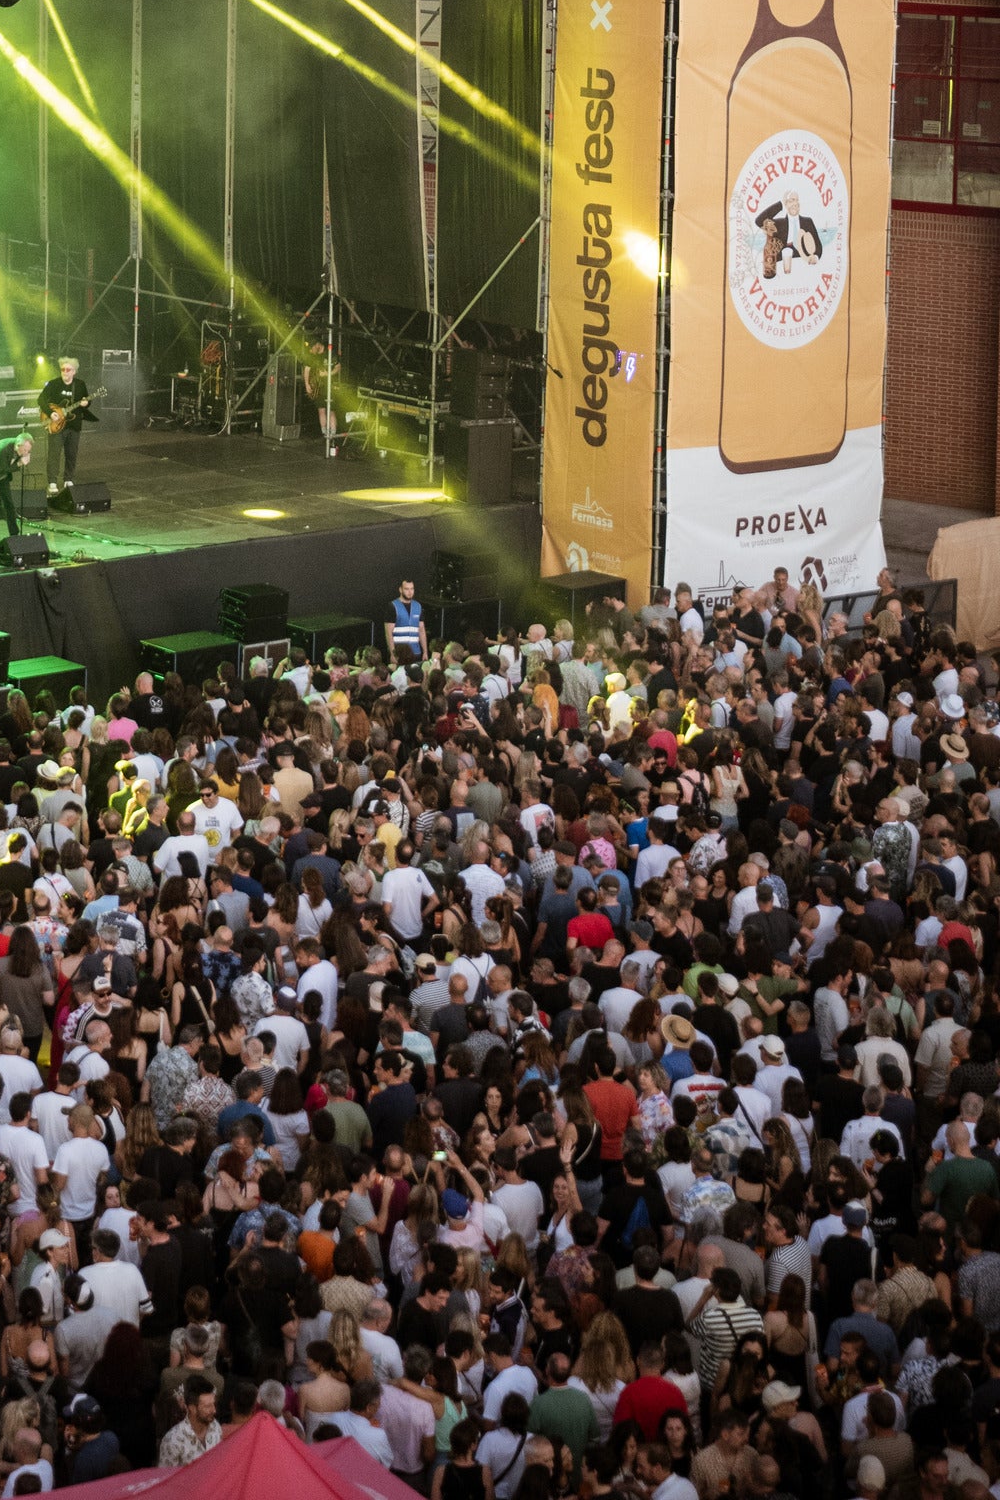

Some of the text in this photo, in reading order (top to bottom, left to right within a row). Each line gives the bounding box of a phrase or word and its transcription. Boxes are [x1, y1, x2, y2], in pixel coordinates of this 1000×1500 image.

[575, 67, 616, 186] fest
[746, 155, 834, 213] CERVEZAS
[749, 273, 832, 325] VICTORIA
[575, 203, 622, 449] degusta
[766, 325, 786, 337] POR
[789, 322, 812, 337] LUIS
[571, 508, 613, 528] Fermasa
[735, 504, 828, 537] PROEXA
[698, 594, 733, 608] Ferm
